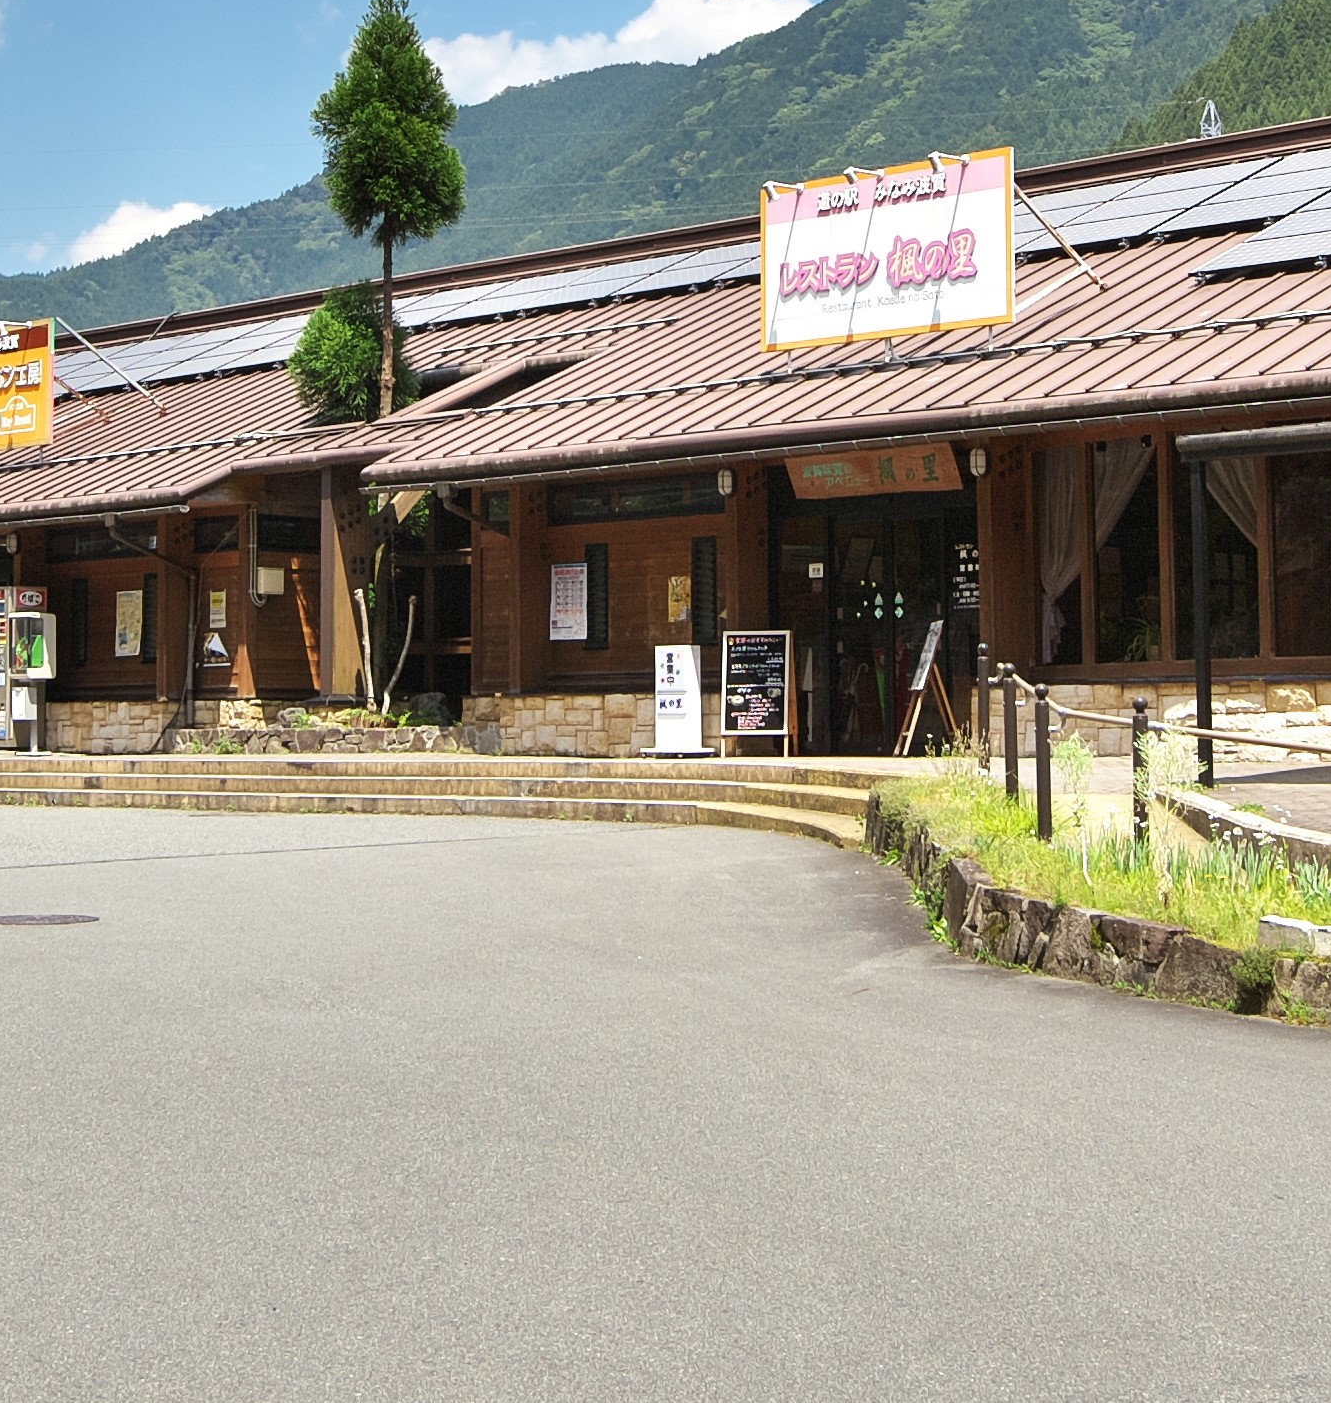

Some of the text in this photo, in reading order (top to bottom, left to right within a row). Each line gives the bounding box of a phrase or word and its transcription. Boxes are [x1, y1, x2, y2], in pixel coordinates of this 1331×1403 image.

[818, 173, 947, 211] 道の駅 みなみ波賀
[781, 229, 978, 296] レストラン 楓の里
[822, 290, 945, 314] Restaurant Kaede no Sato
[879, 452, 940, 485] 楓の里
